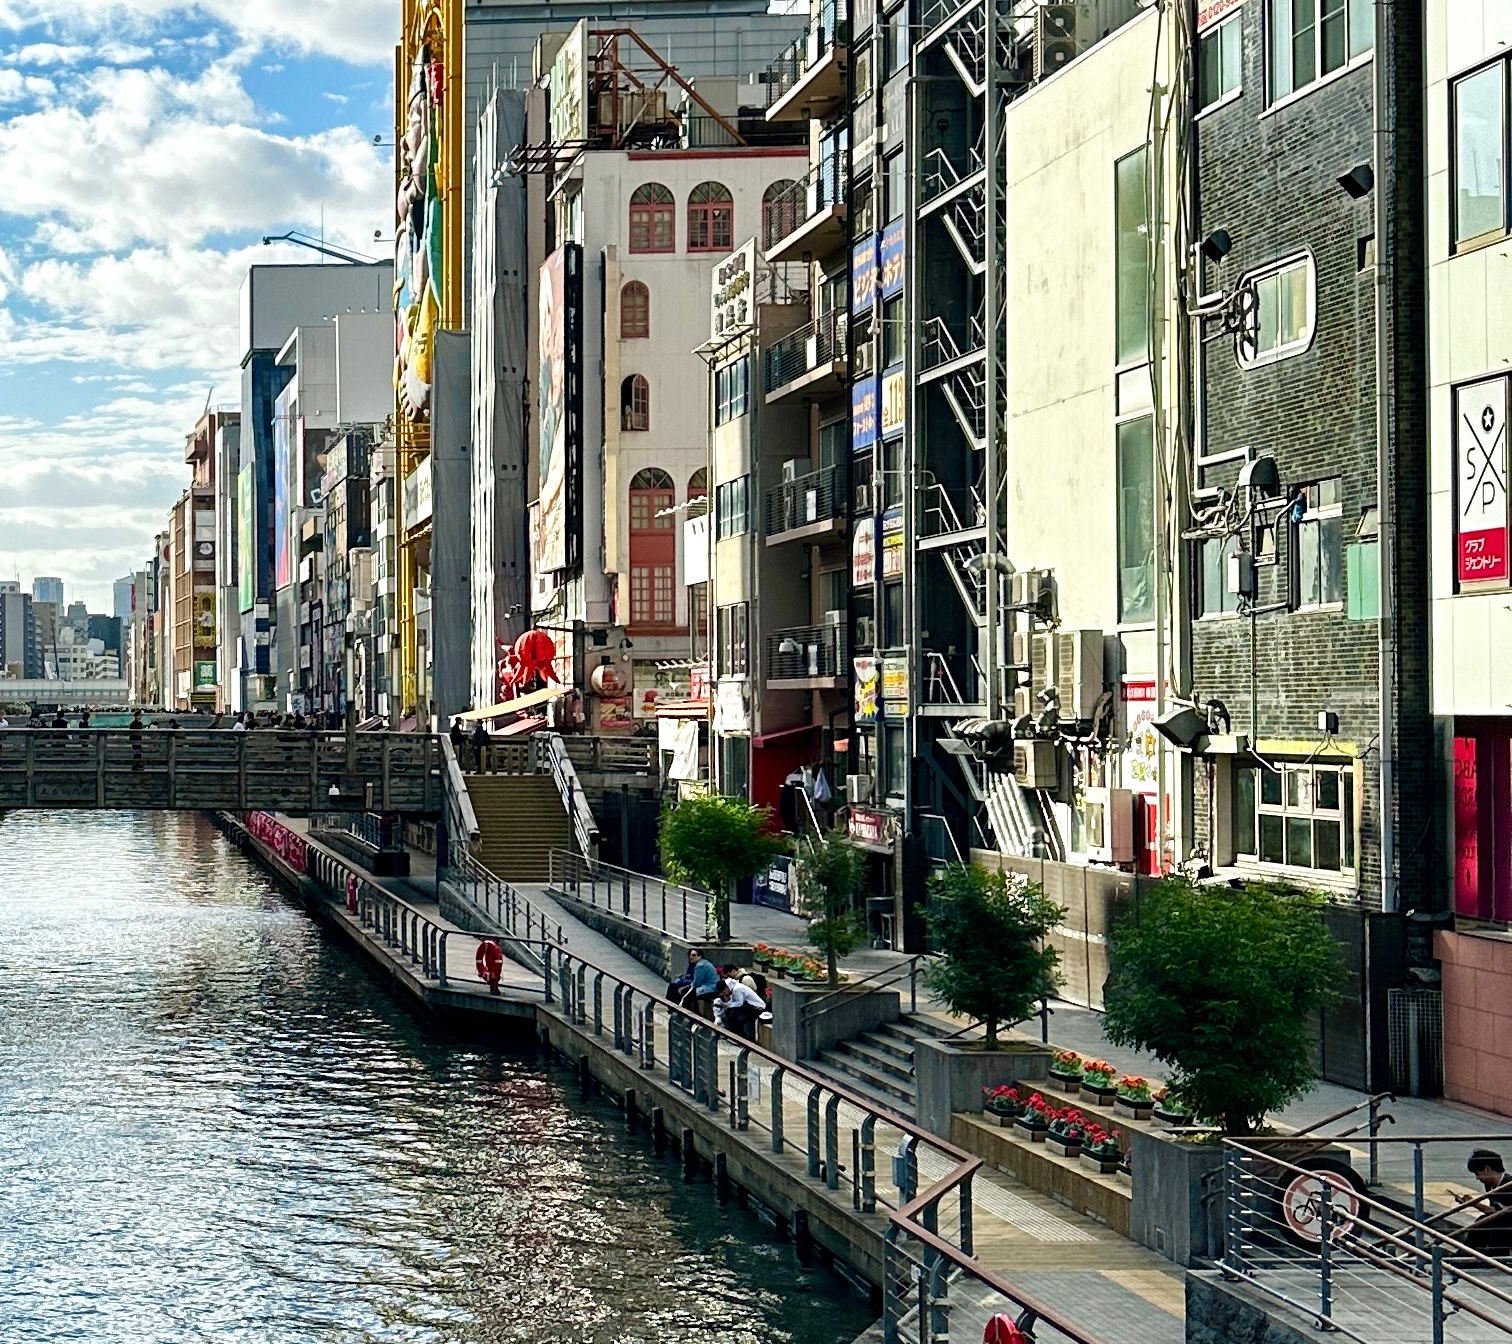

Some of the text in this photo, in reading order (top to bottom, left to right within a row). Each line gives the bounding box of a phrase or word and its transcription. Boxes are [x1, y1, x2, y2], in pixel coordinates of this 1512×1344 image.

[1464, 537, 1486, 554] クラブ
[1464, 555, 1503, 572] ジェントリー
